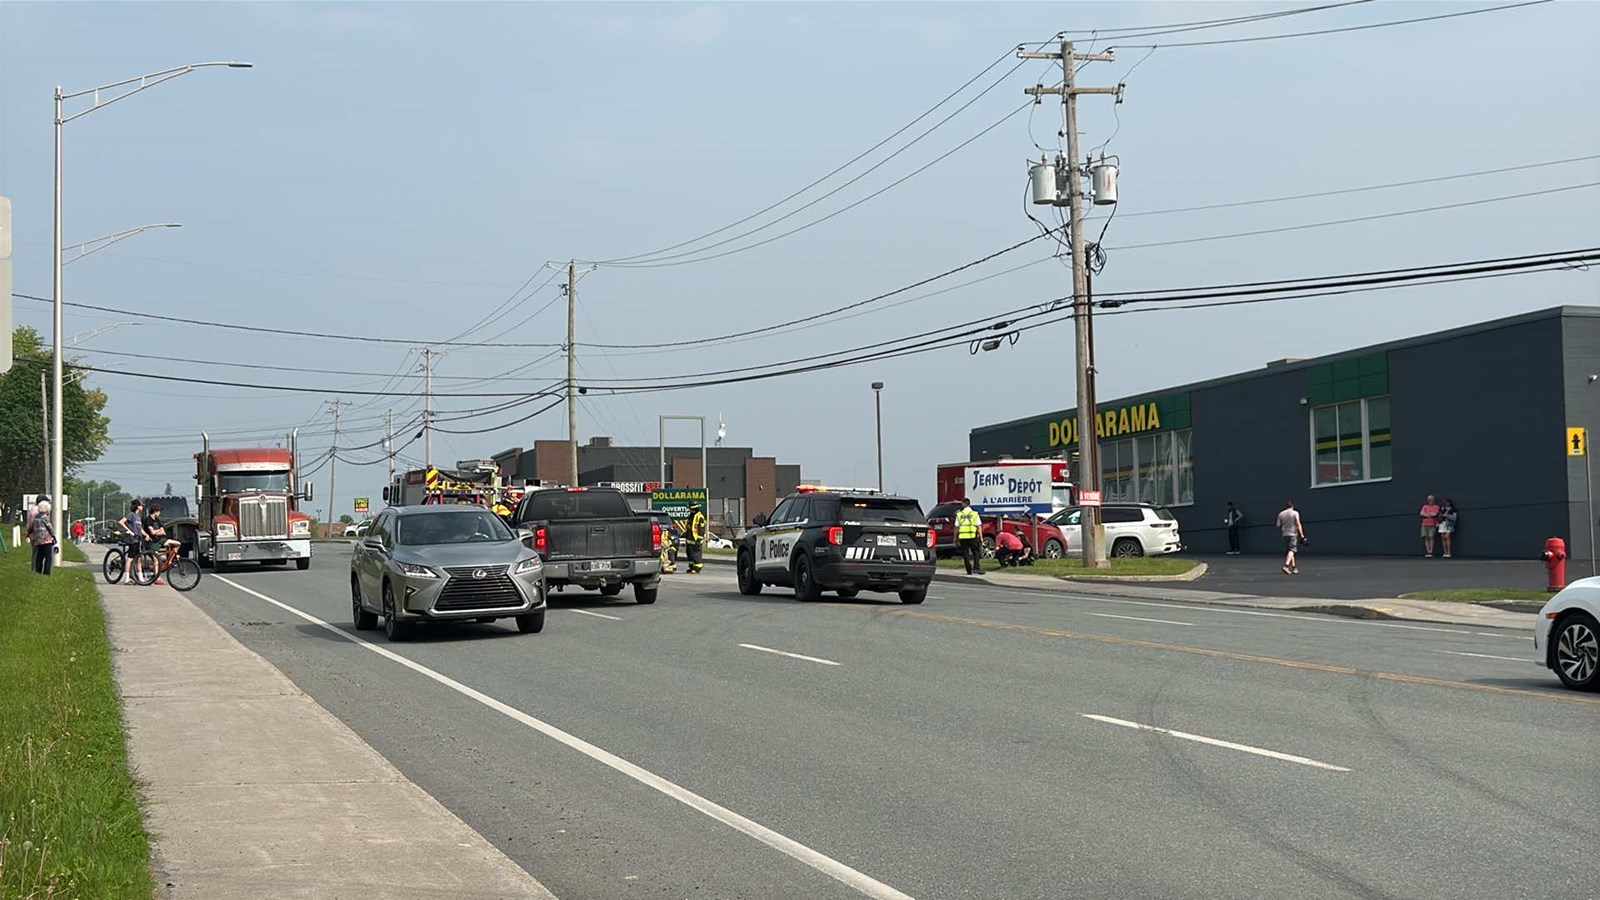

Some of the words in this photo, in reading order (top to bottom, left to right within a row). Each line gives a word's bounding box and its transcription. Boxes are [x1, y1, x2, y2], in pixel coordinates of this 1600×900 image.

[1049, 402, 1160, 446] DOLARAMA
[973, 470, 1005, 491] JEANS
[1008, 478, 1042, 494] DÉPÔT
[990, 495, 1033, 504] L'ARRIÈRE
[769, 540, 789, 558] Police
